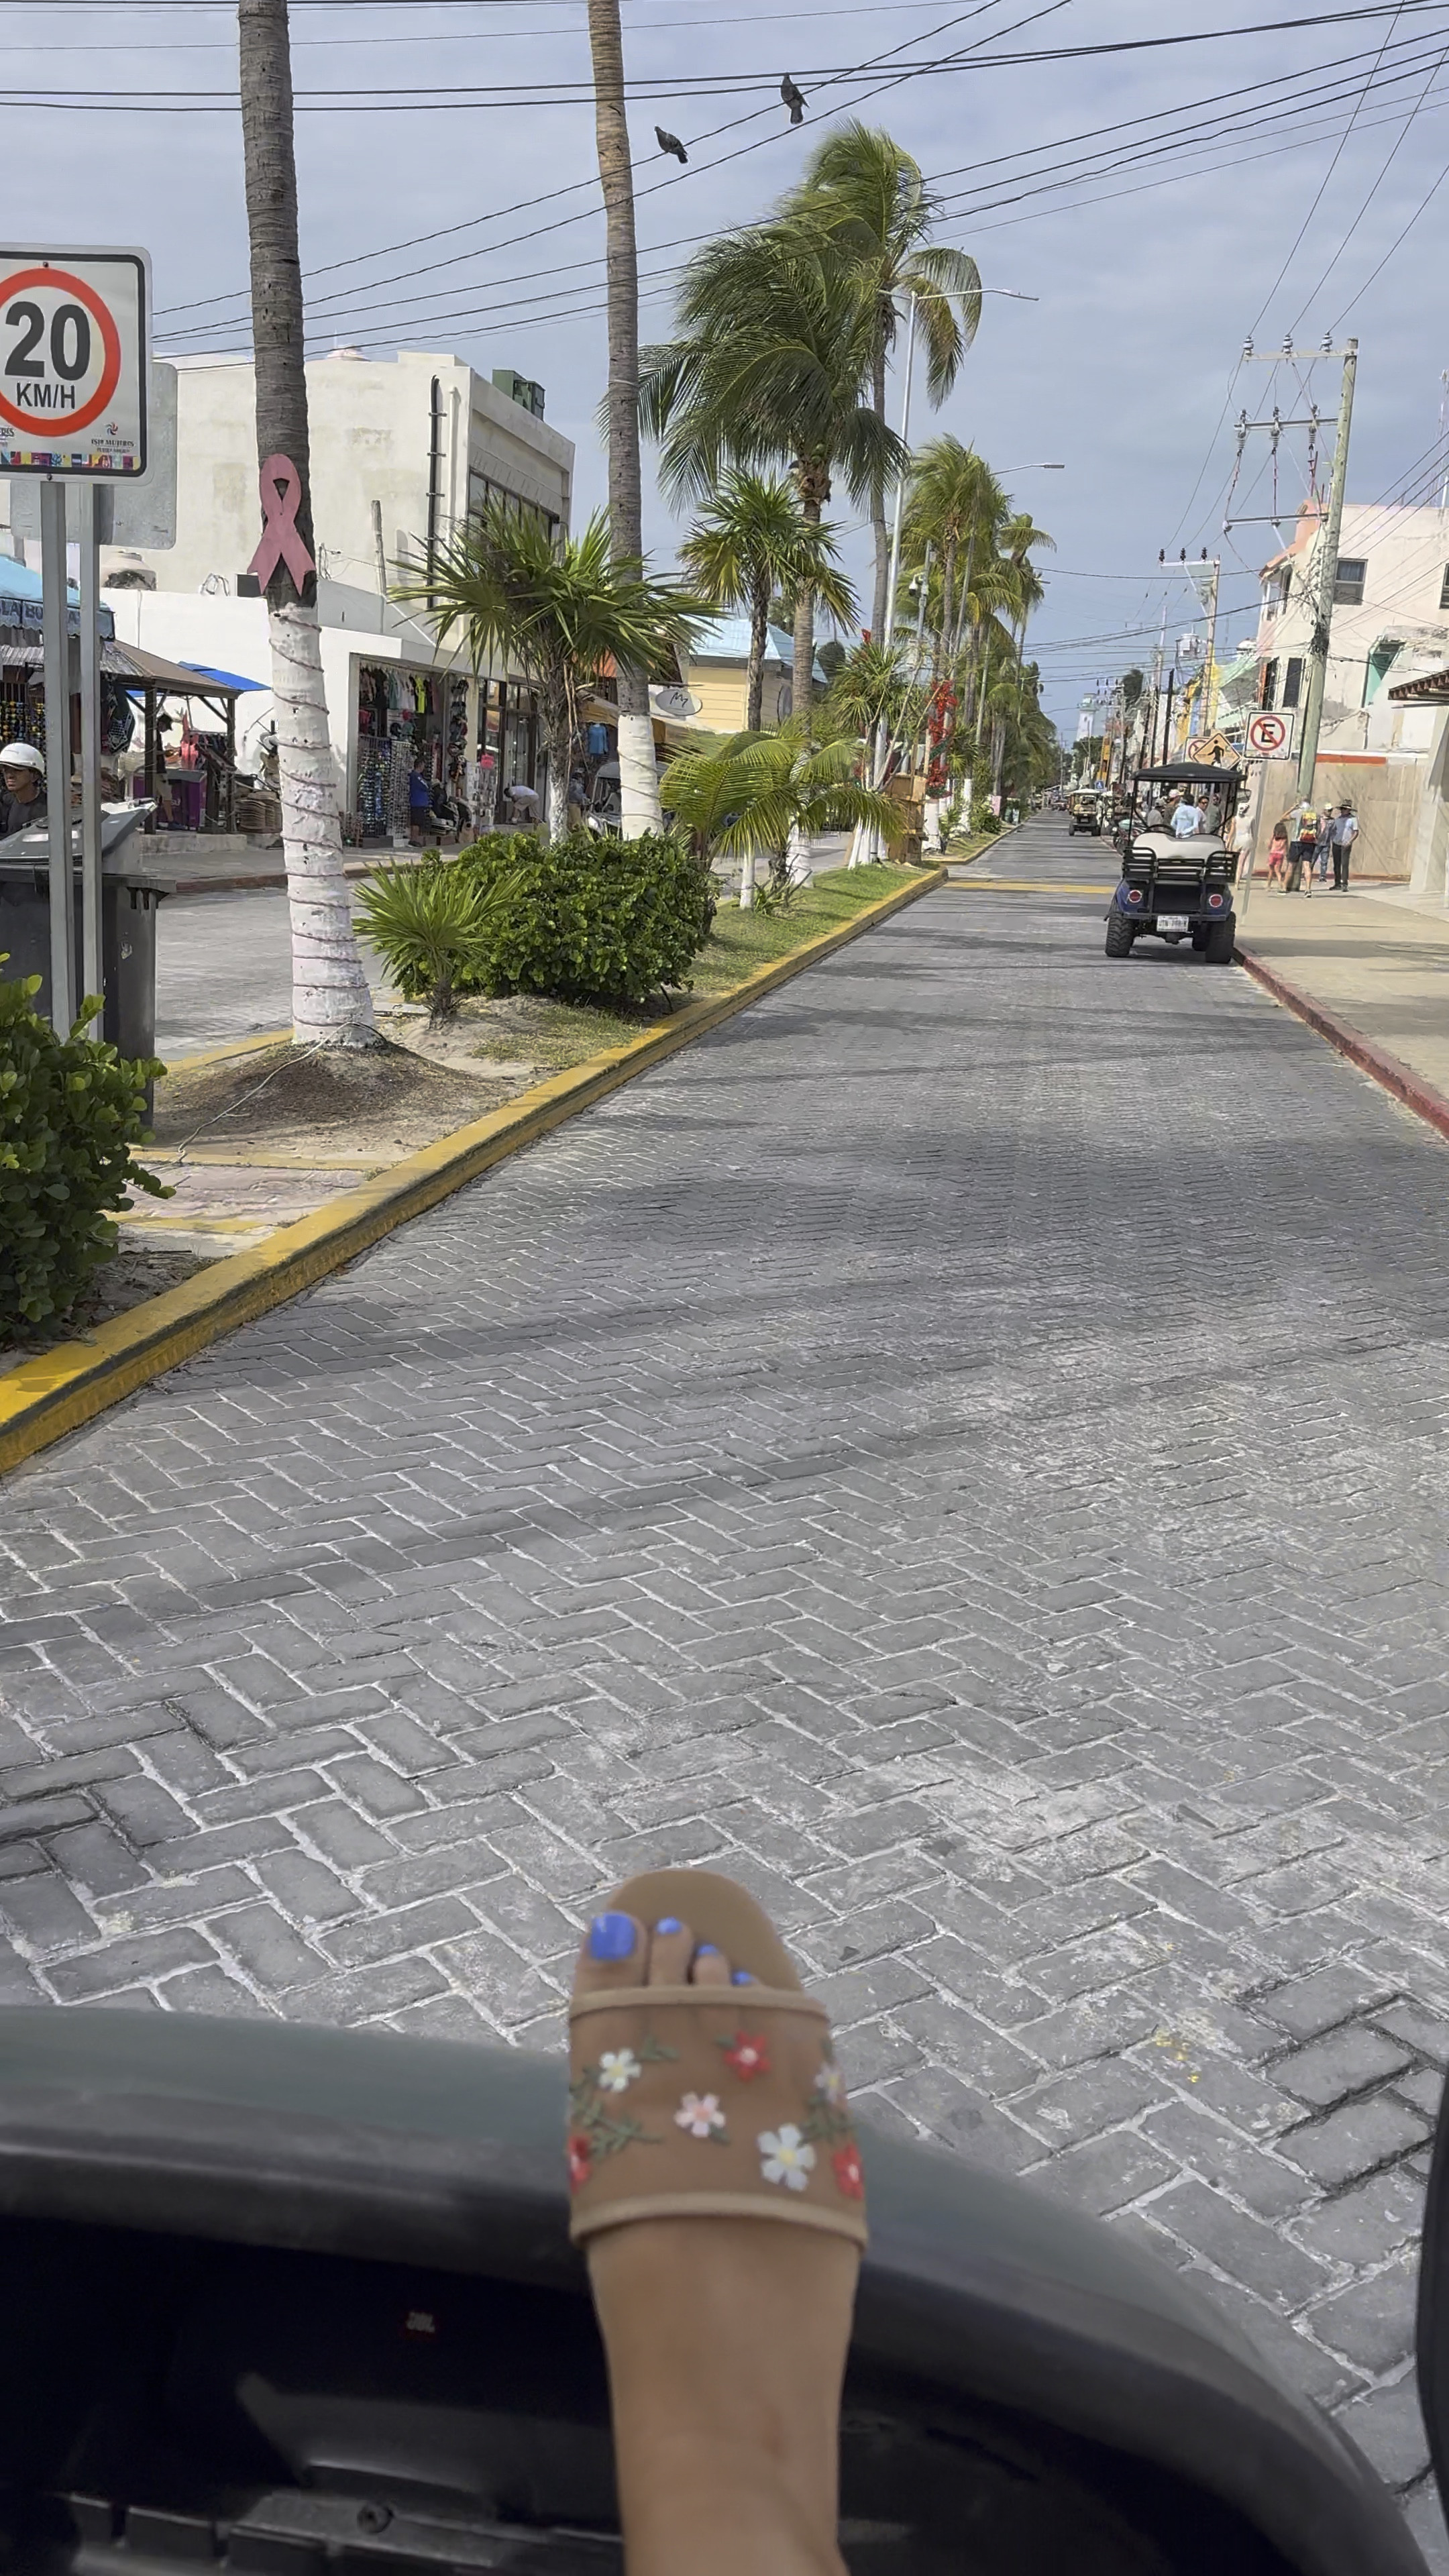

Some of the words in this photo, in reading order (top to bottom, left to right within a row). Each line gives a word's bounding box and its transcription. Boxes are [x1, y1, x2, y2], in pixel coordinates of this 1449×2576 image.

[5, 301, 91, 381] 20
[16, 382, 76, 409] KM/H
[1260, 723, 1276, 743] E
